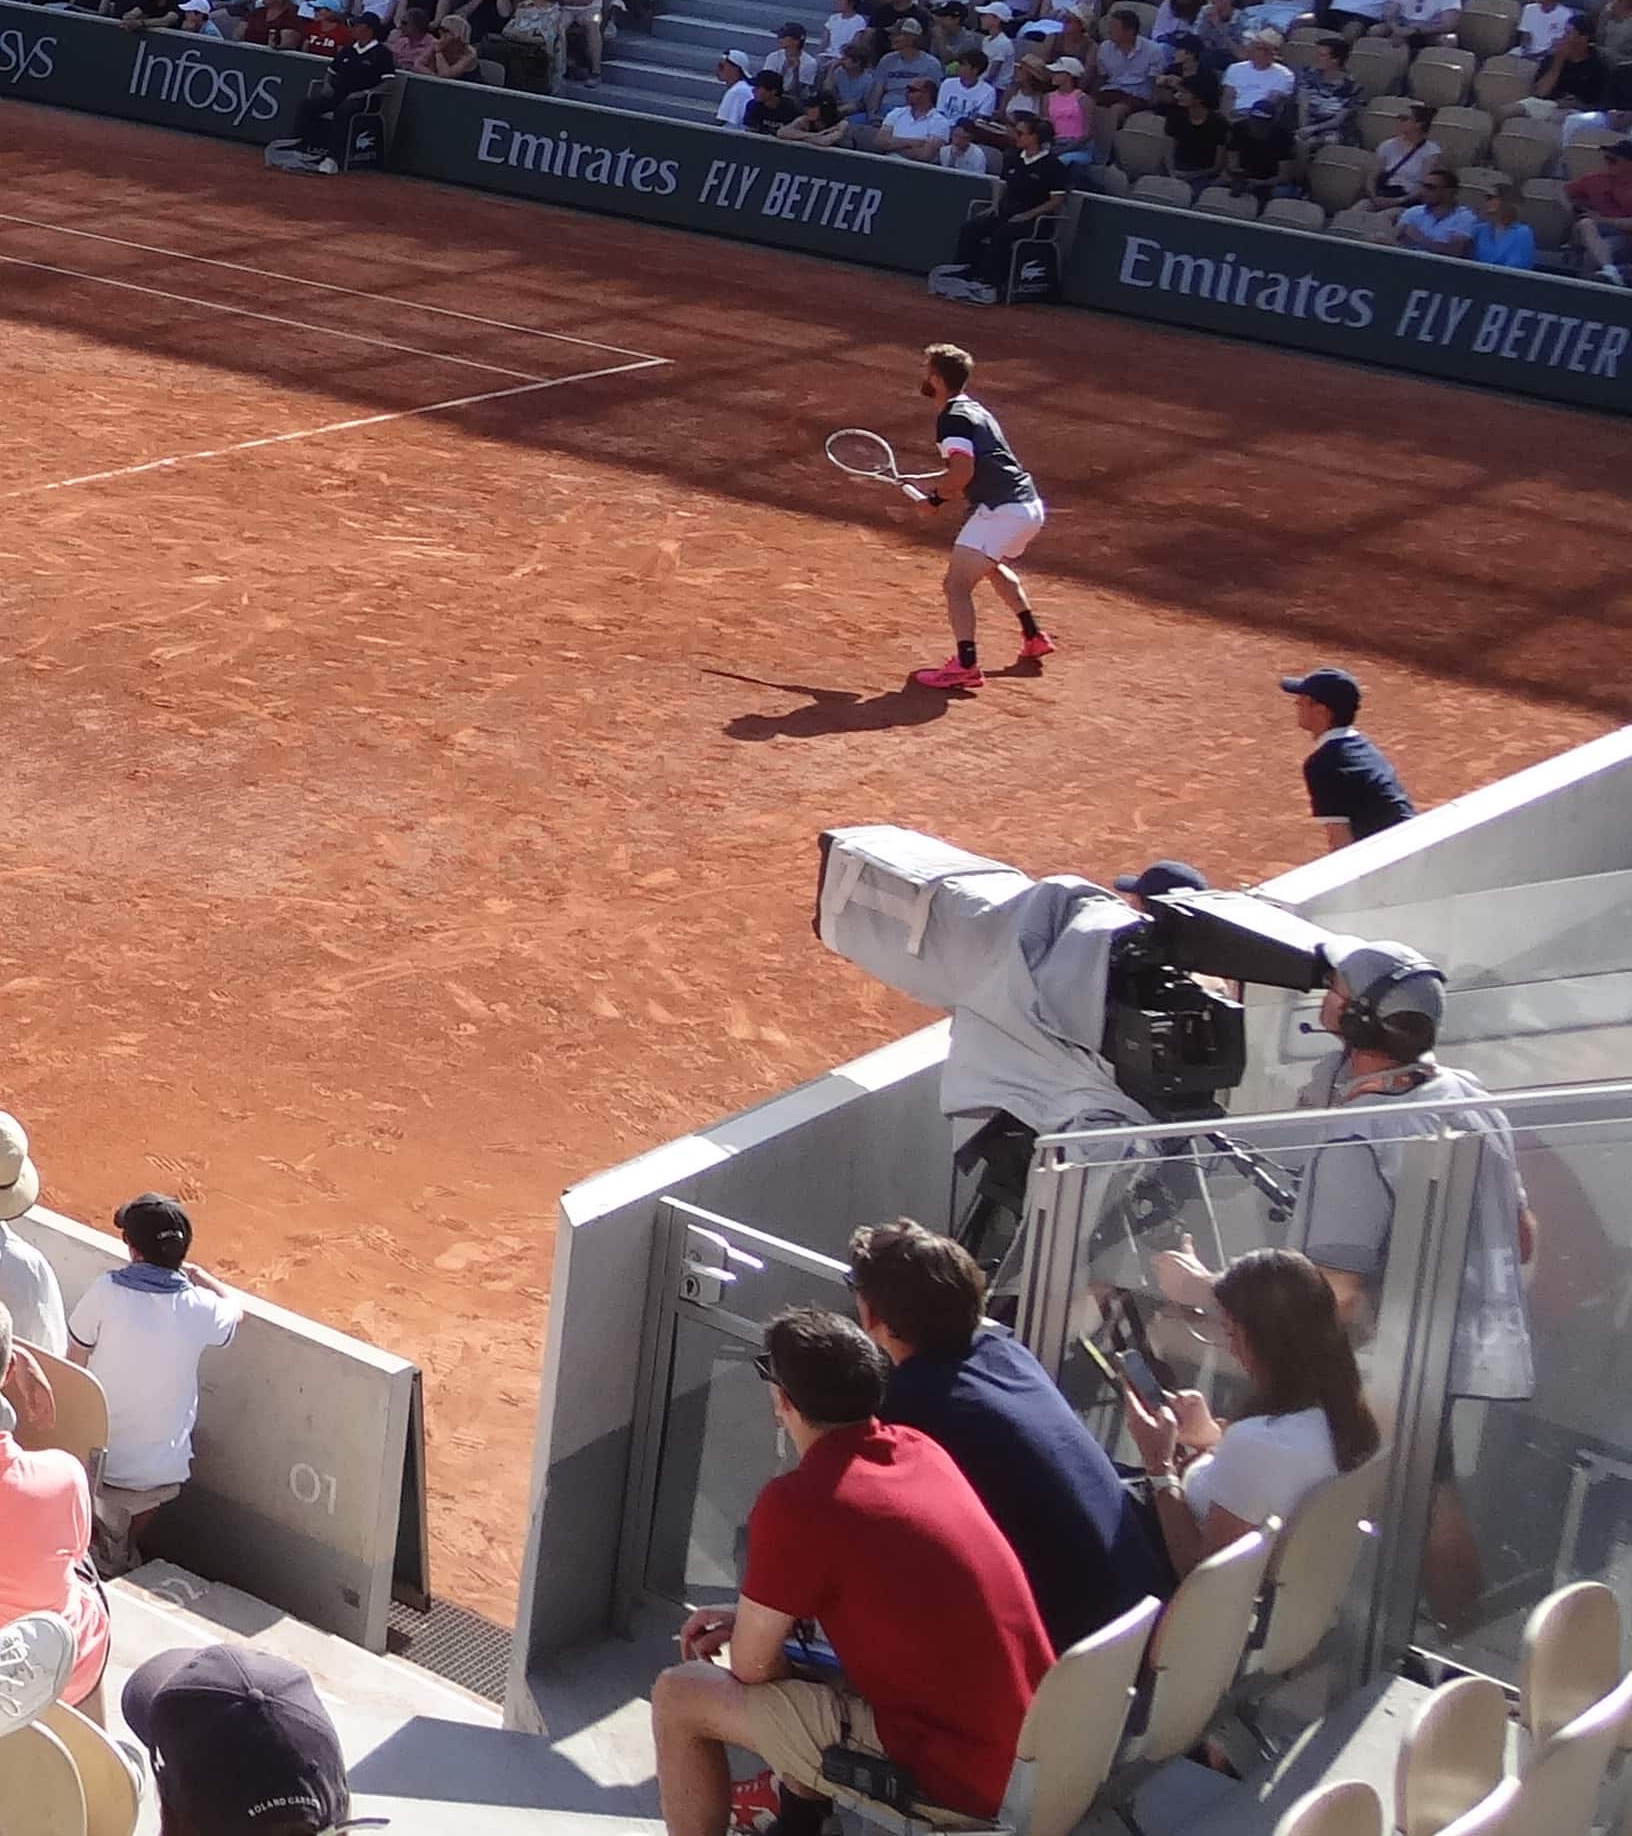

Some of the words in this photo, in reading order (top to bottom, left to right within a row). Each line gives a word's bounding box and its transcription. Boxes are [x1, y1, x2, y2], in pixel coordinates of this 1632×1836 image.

[128, 40, 284, 127] Infosys
[476, 117, 680, 197] Emirates
[697, 159, 762, 210] FLY
[761, 171, 883, 236] BETTER
[1118, 235, 1376, 329] Emirates
[1395, 289, 1476, 345] FLY
[1472, 304, 1630, 379] BETTER
[288, 1463, 338, 1516] 01
[247, 1796, 287, 1818] ROLAND
